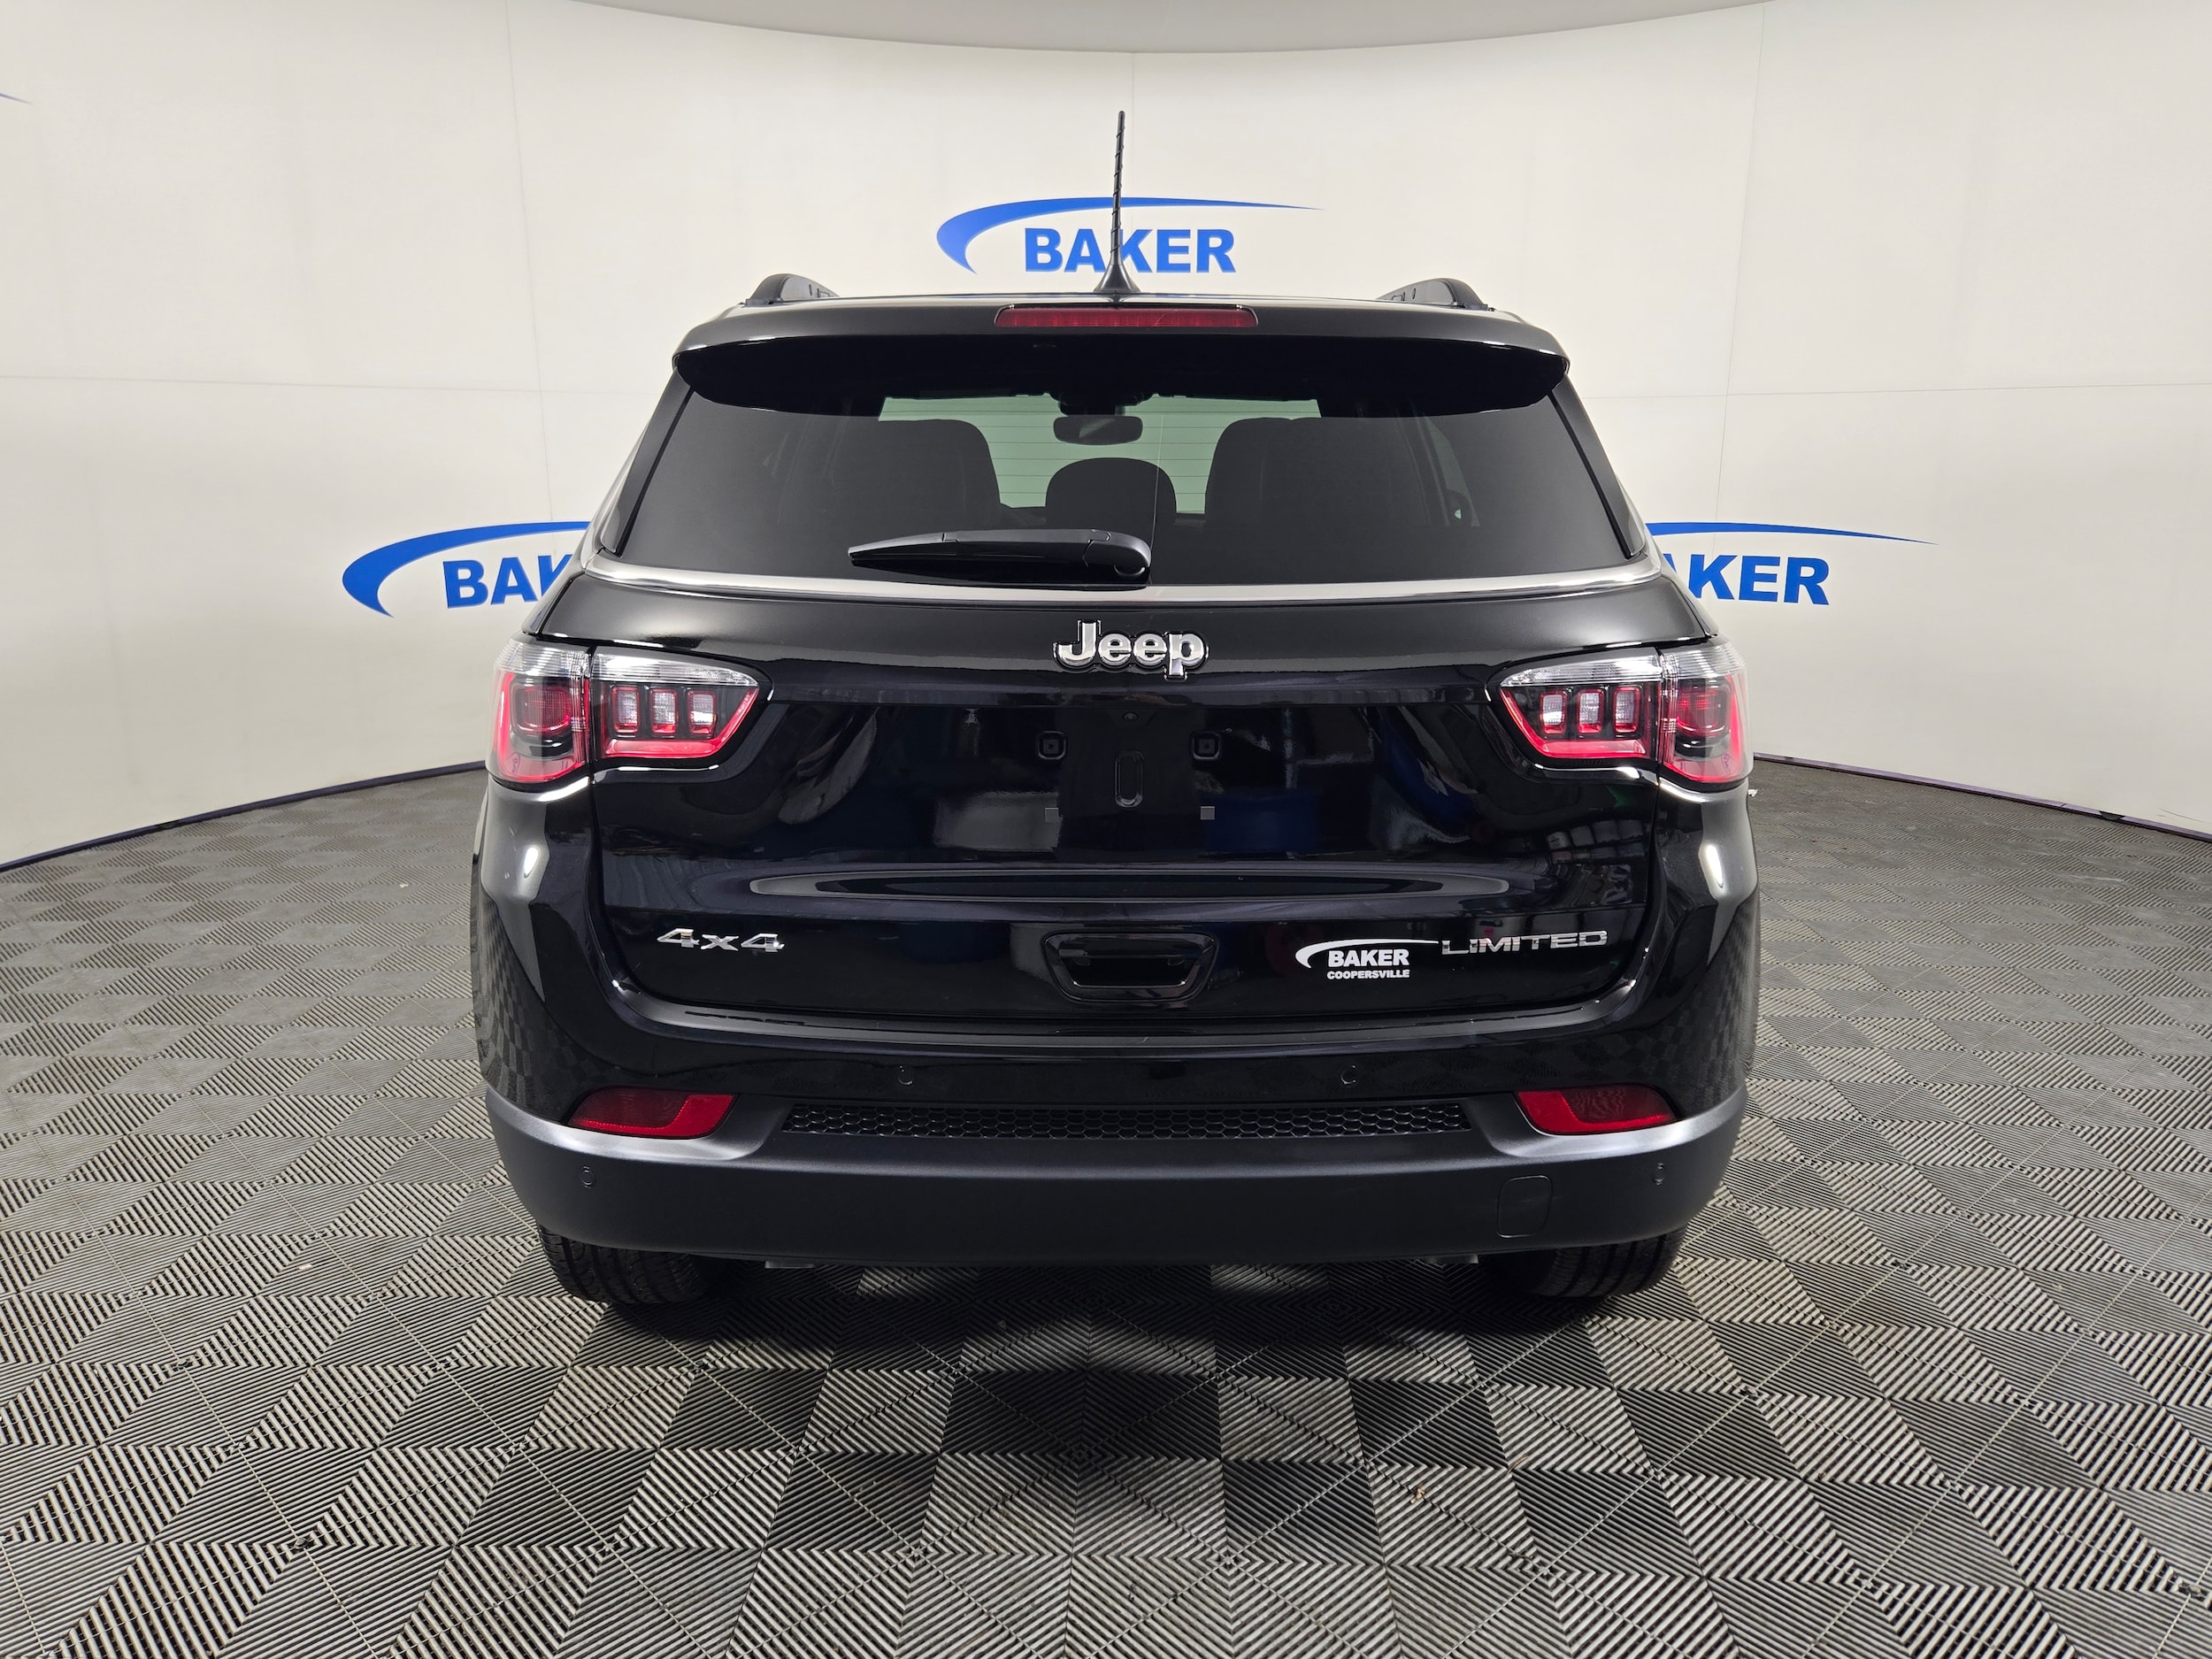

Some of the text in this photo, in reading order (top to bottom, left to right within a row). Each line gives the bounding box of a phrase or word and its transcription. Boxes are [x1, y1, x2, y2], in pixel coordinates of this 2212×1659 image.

[1025, 227, 1236, 273] BAKER
[1663, 553, 1830, 606] KER
[1055, 619, 1208, 680] Jeep
[657, 927, 786, 953] 4x4
[1440, 930, 1608, 955] LIMITED
[1327, 949, 1410, 968] BAKER
[1326, 969, 1410, 980] COOPERSVILLE
